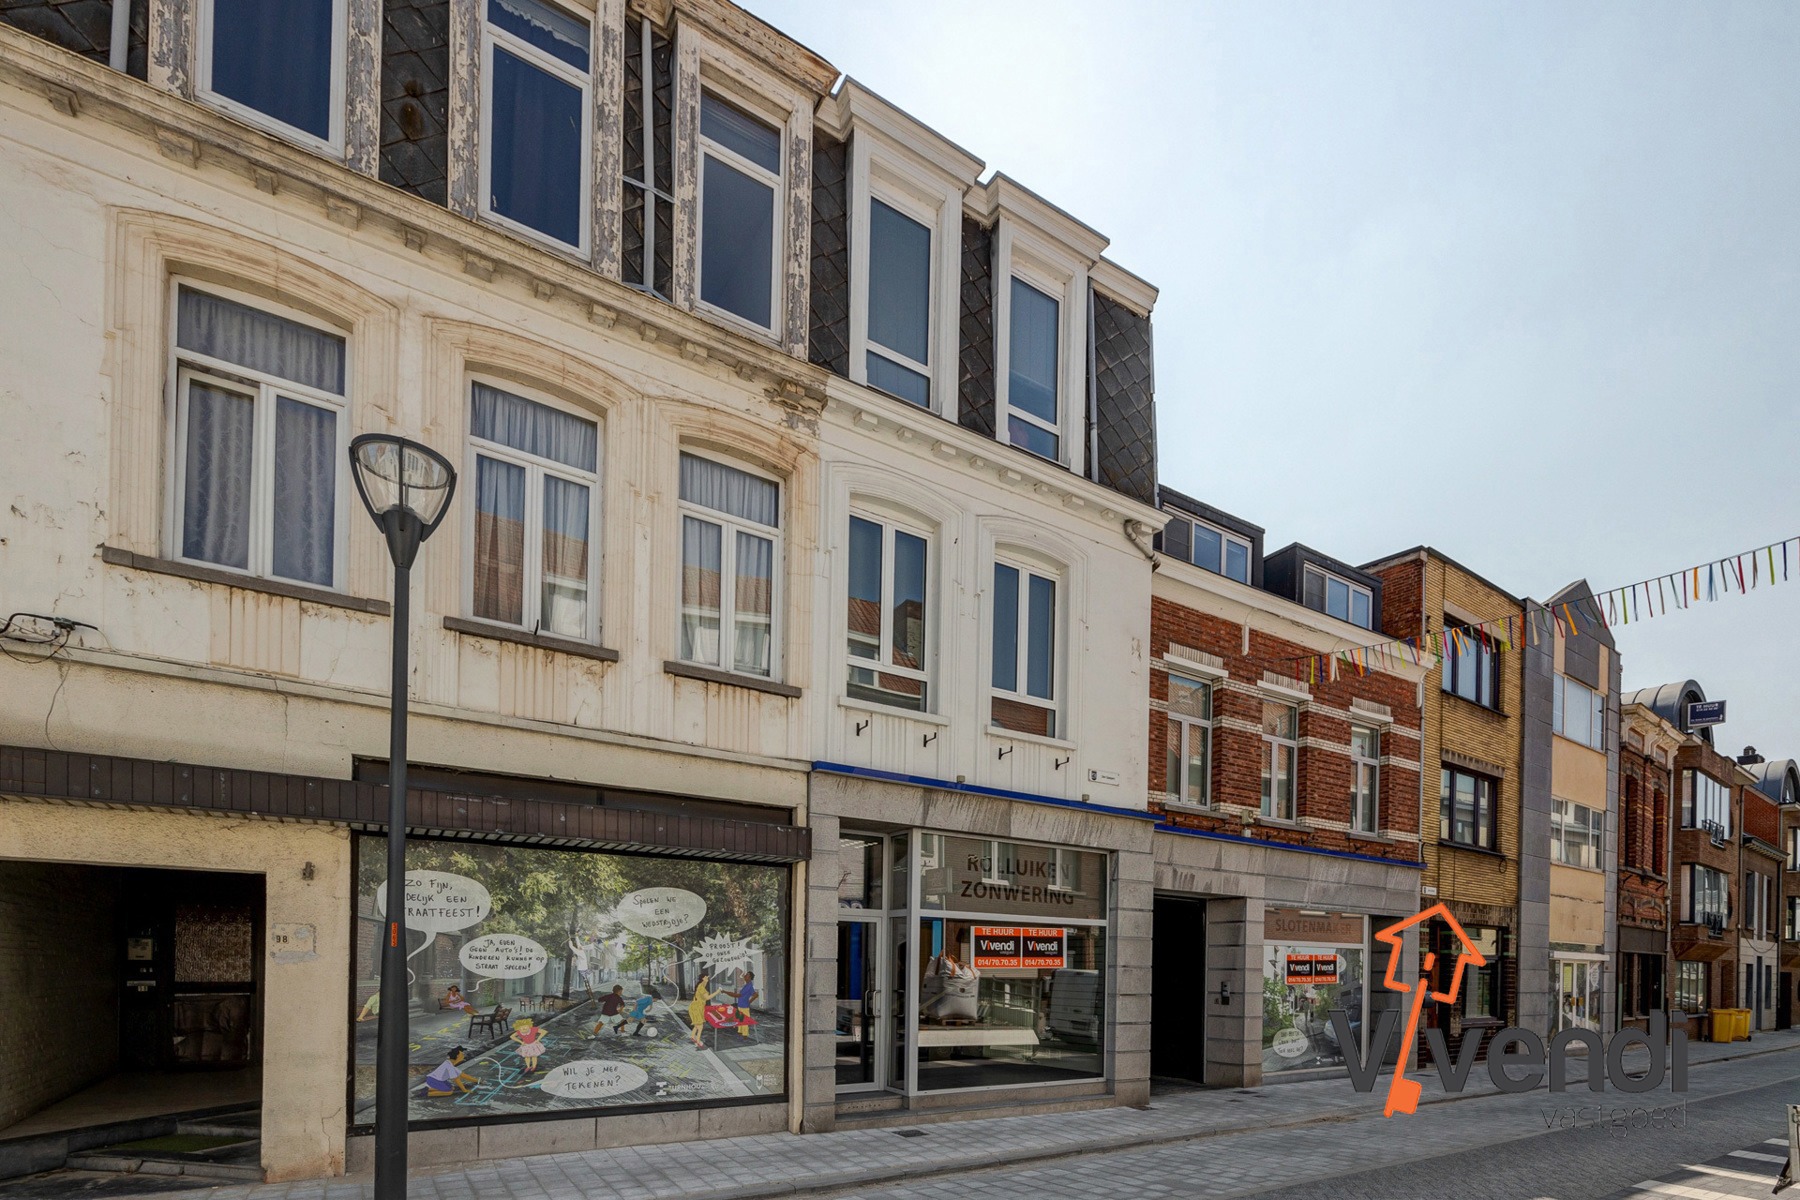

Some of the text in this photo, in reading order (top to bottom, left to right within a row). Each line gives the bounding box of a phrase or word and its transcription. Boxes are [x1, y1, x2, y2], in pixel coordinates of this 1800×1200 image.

[967, 854, 1070, 879] ROLLUIKEN
[961, 880, 1074, 905] ZONWERING
[406, 892, 467, 906] DELIJK EEN
[405, 905, 480, 918] RAATFEEST!
[654, 908, 670, 916] EEN
[993, 928, 1015, 936] HUUR
[1028, 928, 1058, 937] TE HUUR
[1275, 919, 1352, 934] SLOTENMAKER
[275, 934, 288, 943] 98
[980, 940, 1015, 951] Vivendi
[1027, 940, 1058, 952] Vivendi
[563, 1065, 619, 1077] WIL JE MEE
[564, 1075, 621, 1091] TEKENEN?
